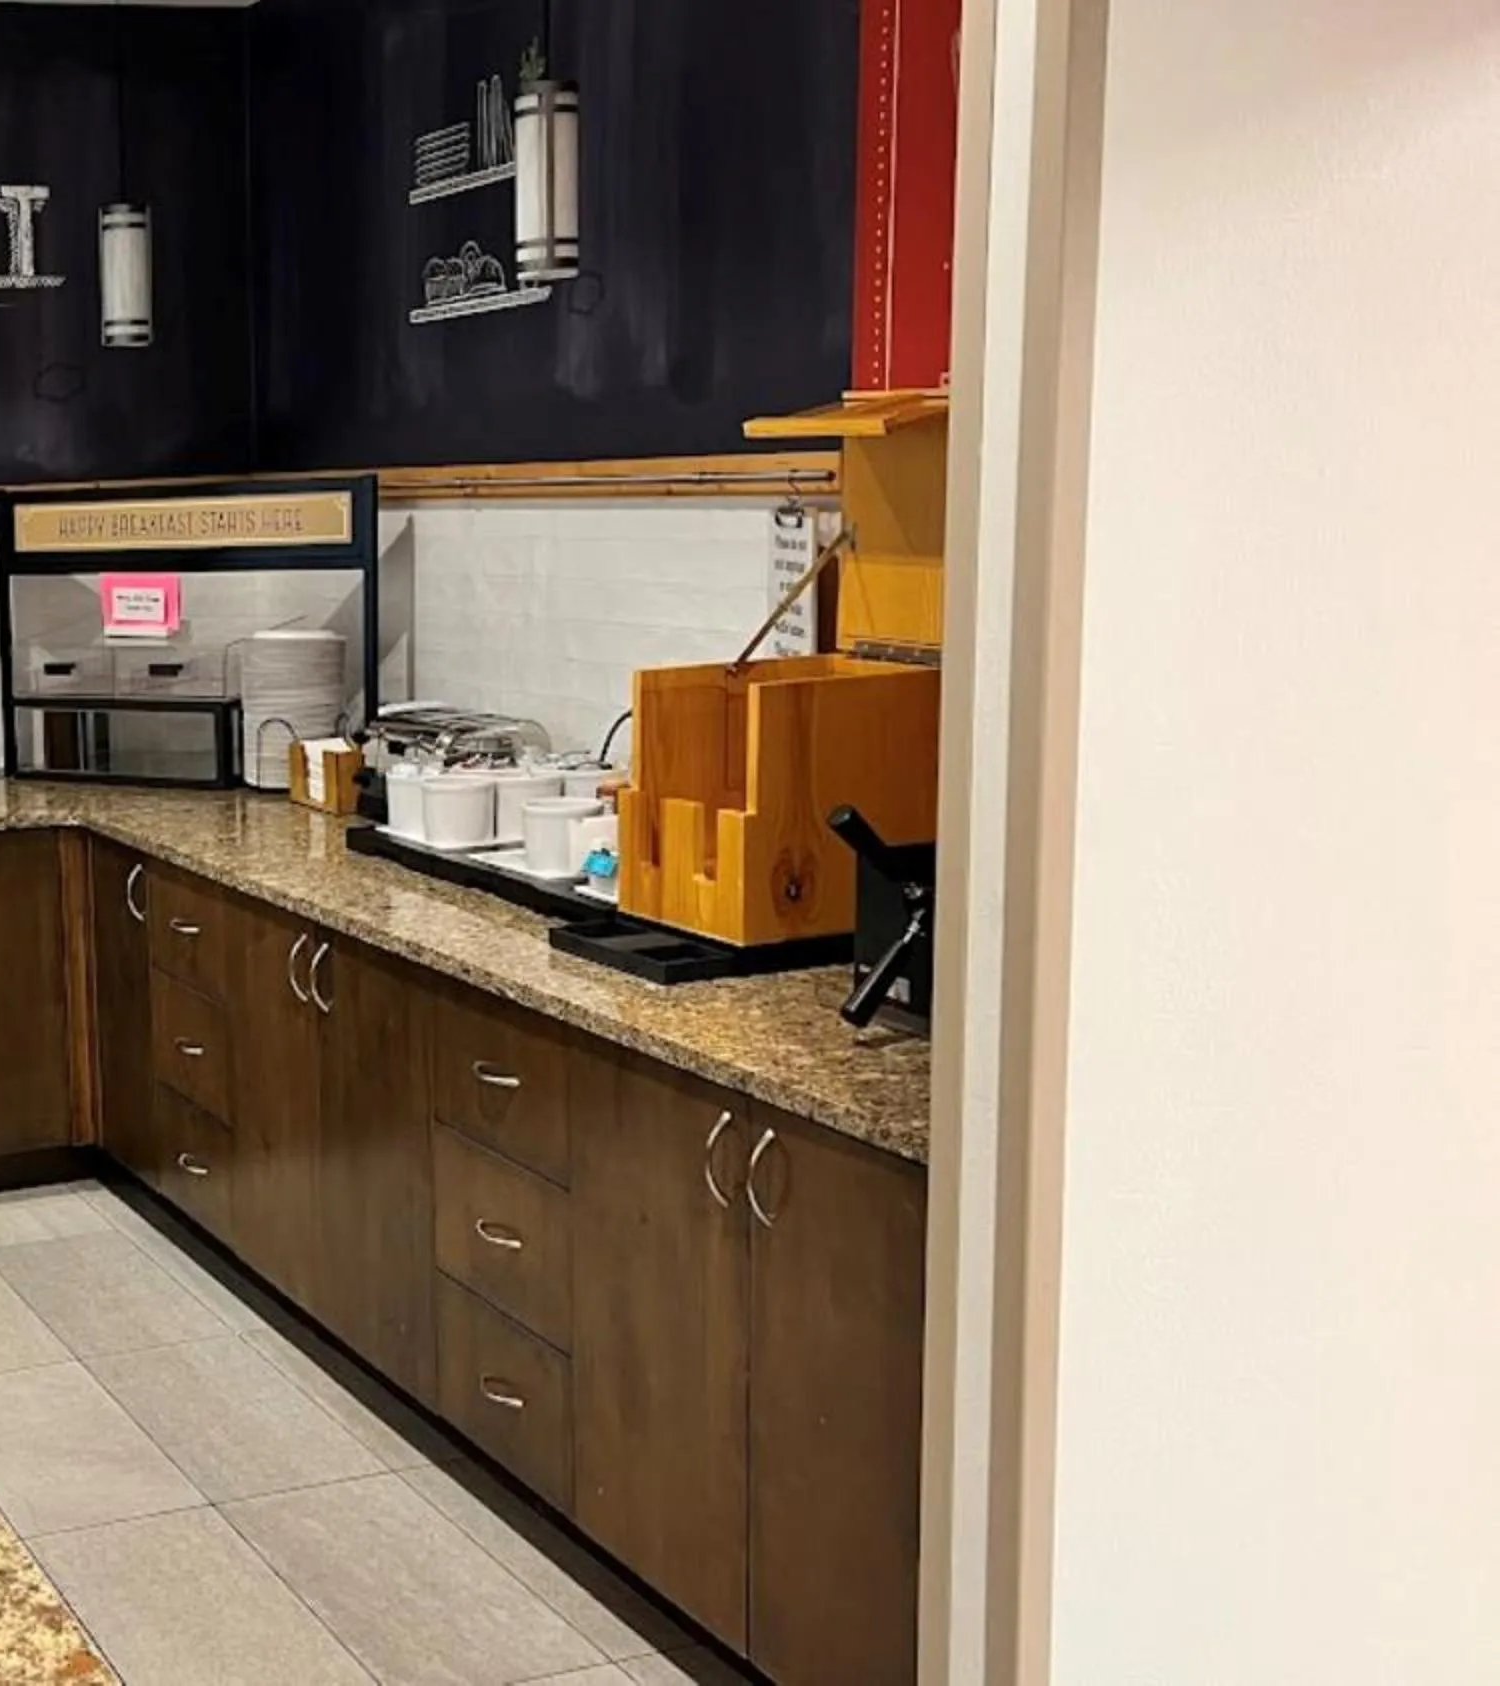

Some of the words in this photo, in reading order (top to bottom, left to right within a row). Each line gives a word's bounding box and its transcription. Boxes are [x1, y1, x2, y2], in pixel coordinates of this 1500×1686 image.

[58, 516, 105, 538] HAPPY
[111, 513, 192, 537] BREAKFAST
[199, 510, 257, 536] STARTS
